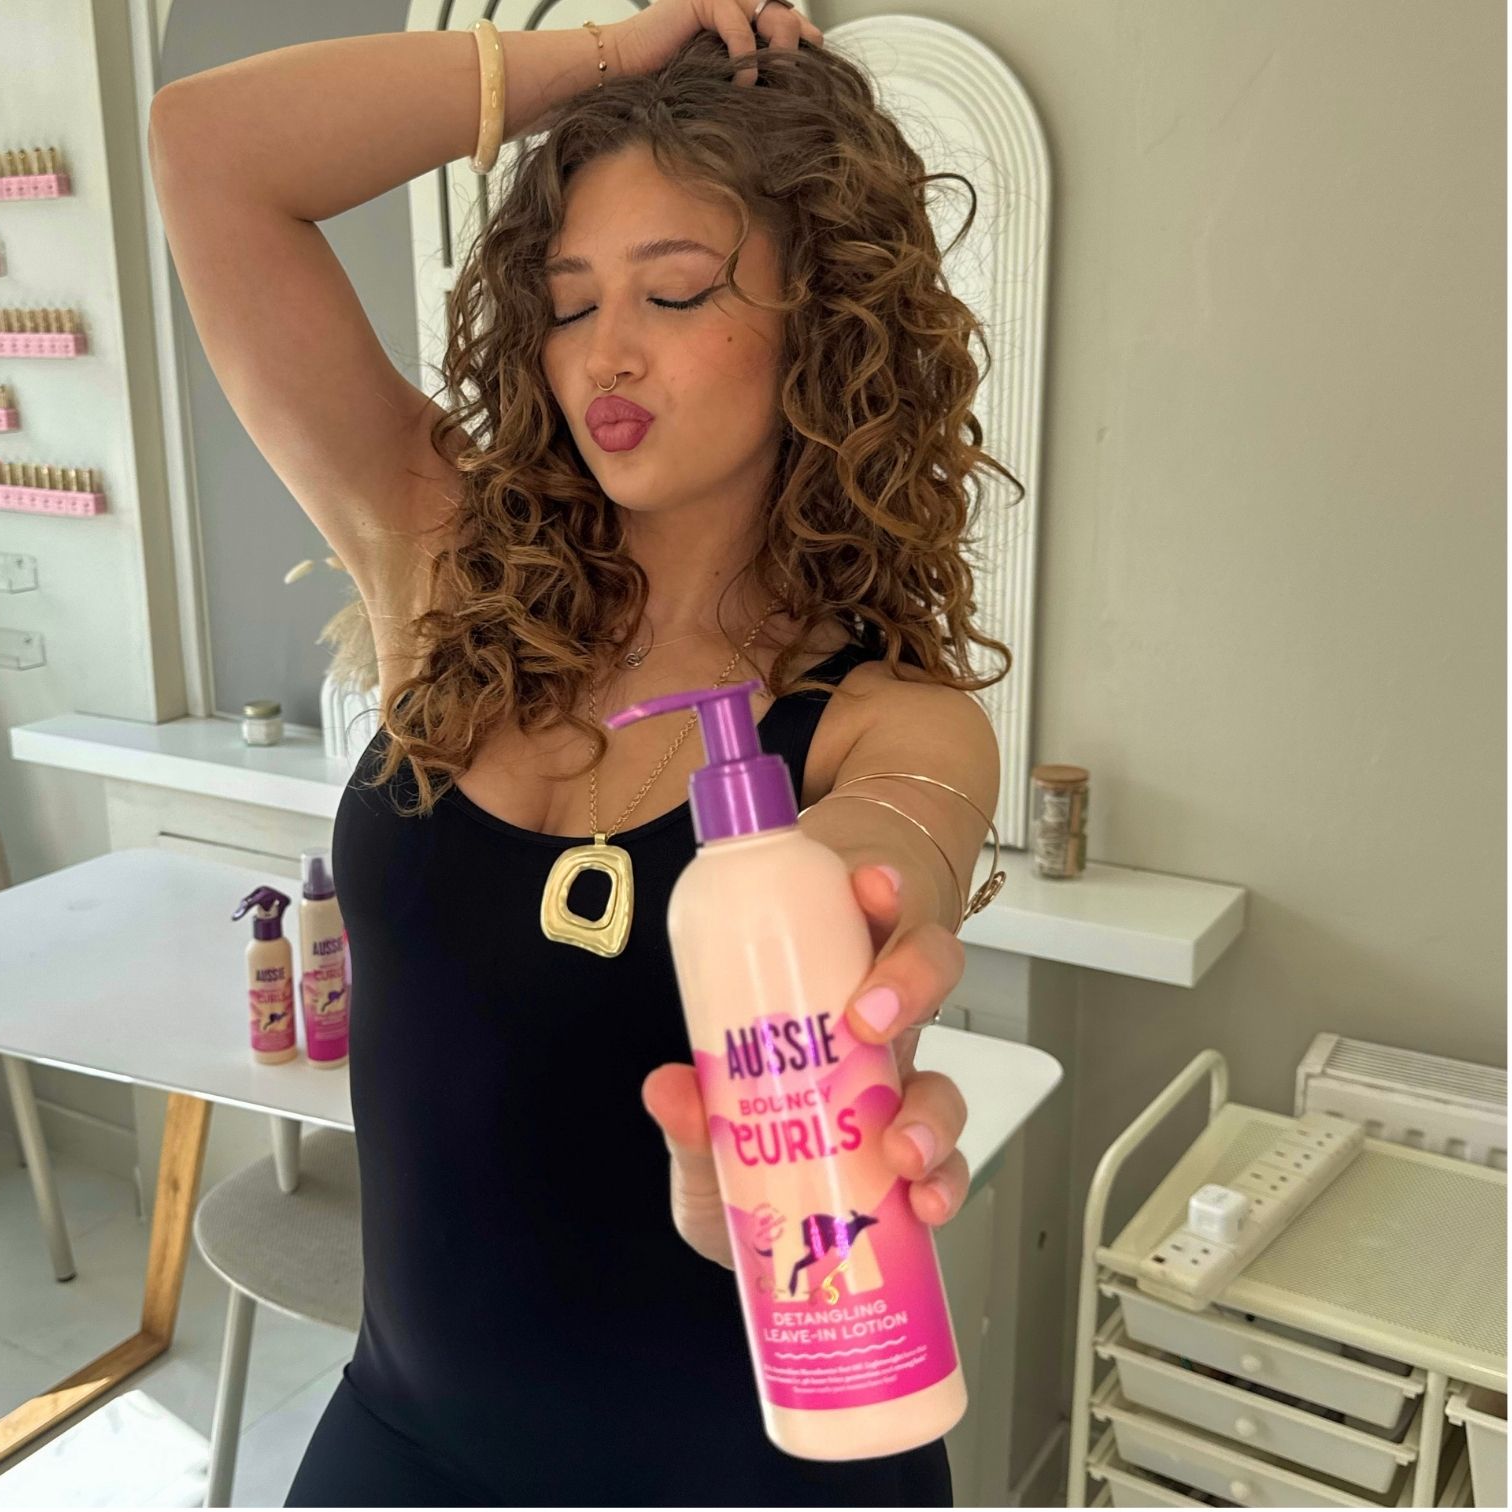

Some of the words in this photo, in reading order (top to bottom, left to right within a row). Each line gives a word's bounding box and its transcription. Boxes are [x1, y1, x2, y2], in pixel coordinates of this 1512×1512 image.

[256, 968, 285, 982] AUSSIE
[725, 1012, 839, 1080] AUSSIE
[739, 1087, 833, 1116] BOUNCY
[730, 1109, 862, 1166] CURLS
[763, 1328, 837, 1343] LEAVE-IN
[842, 1311, 908, 1339] LOTION
[772, 1299, 887, 1326] DETANGLING
